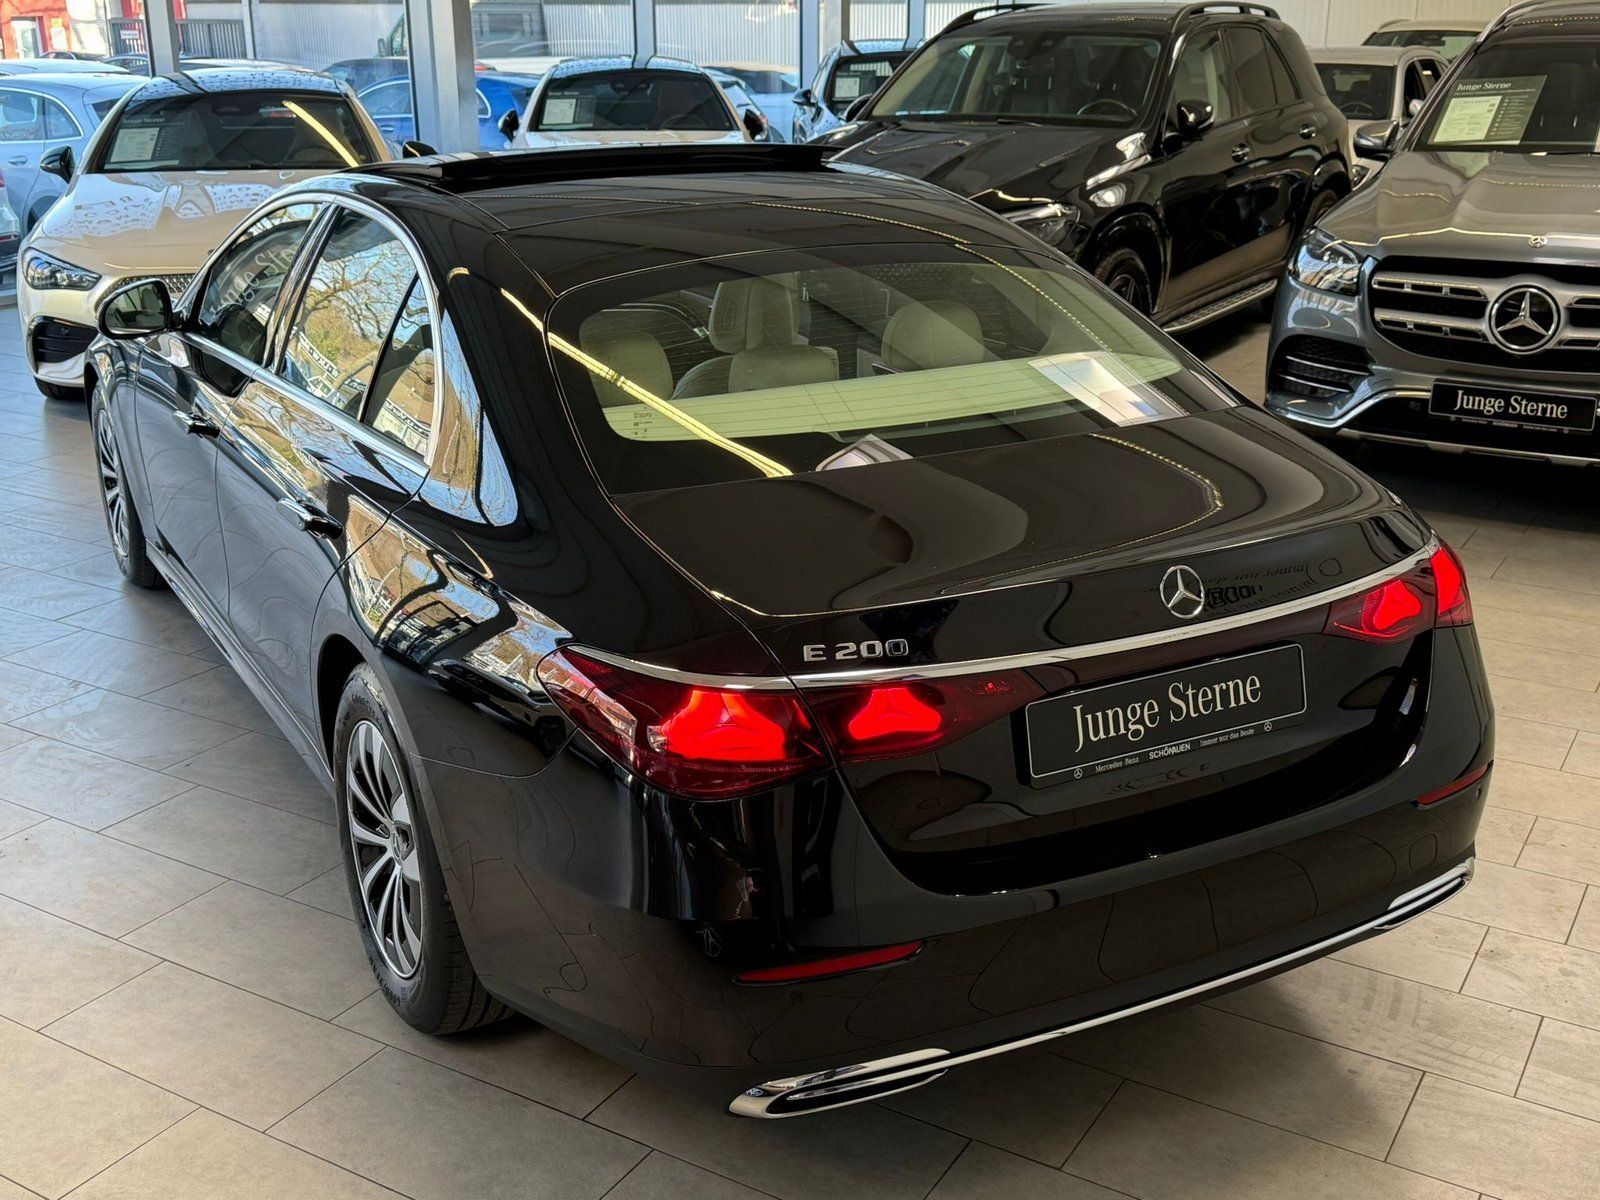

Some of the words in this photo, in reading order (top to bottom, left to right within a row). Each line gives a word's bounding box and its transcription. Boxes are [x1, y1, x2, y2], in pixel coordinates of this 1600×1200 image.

[1456, 83, 1482, 92] Junge
[1483, 81, 1512, 90] Sterne
[1453, 389, 1505, 416] Junge
[1508, 395, 1568, 419] Sterne
[803, 644, 827, 662] E
[835, 638, 909, 661] 200
[1072, 698, 1160, 753] Junge
[1168, 674, 1262, 723] Sterne
[1095, 757, 1139, 773] Mercedes-Benz
[1149, 742, 1191, 760] SCHÖNAUEN
